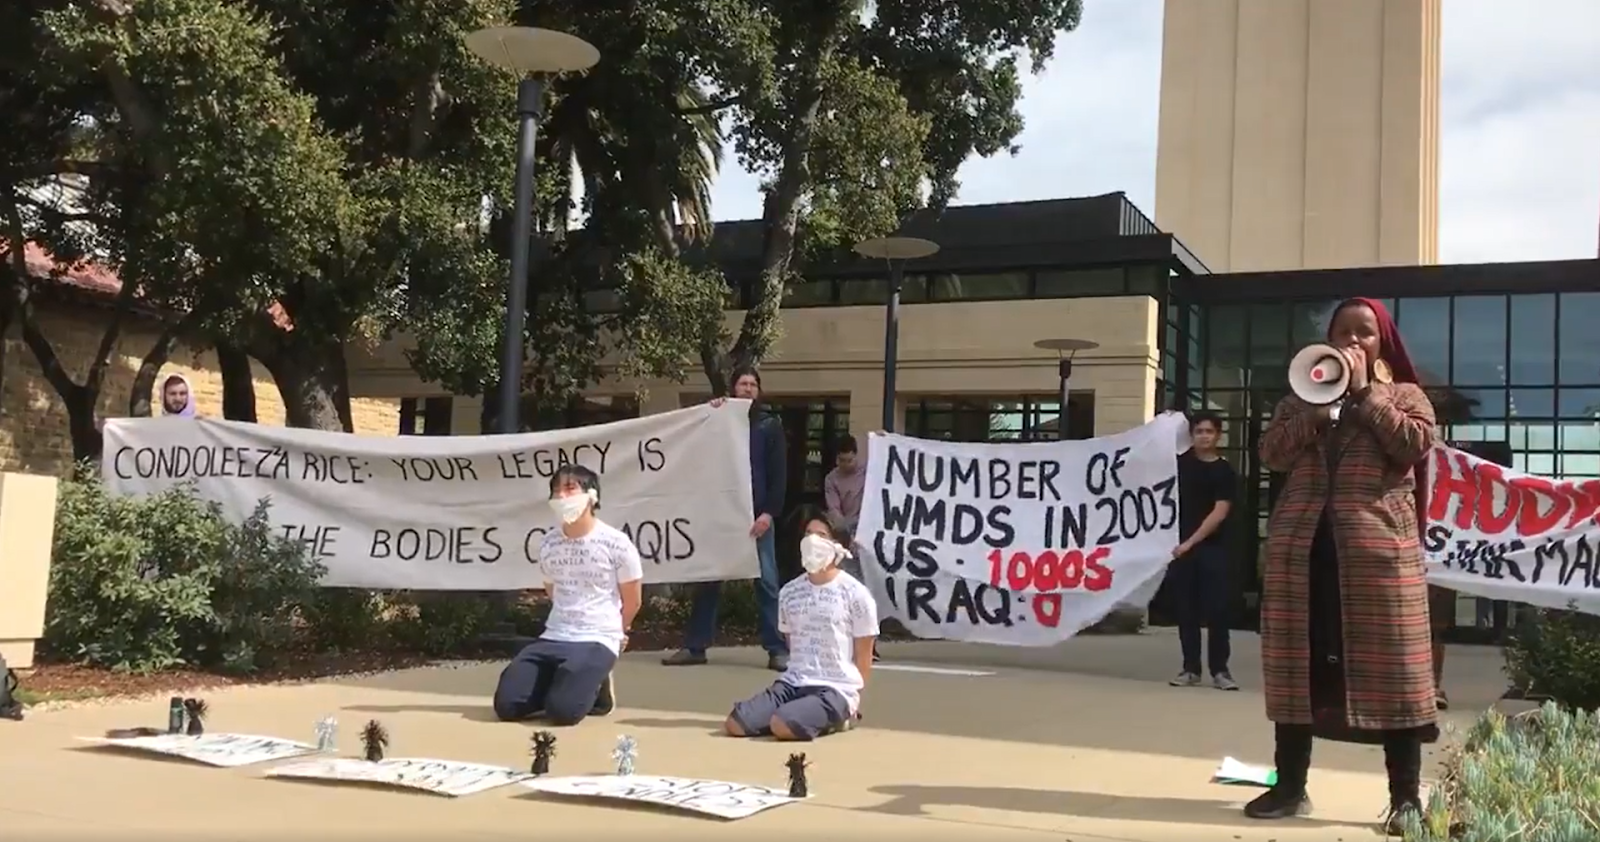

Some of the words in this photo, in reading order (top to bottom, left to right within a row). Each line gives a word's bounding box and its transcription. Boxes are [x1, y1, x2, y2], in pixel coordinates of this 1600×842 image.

[302, 452, 373, 484] RICE:
[392, 456, 478, 481] YOUR
[638, 437, 666, 472] IS
[885, 445, 1061, 501] NUMBER
[1086, 447, 1131, 495] OF
[881, 488, 1015, 548] WMDS
[1044, 503, 1087, 549] IN
[1095, 474, 1177, 545] 2003
[370, 526, 503, 563] BODIES
[987, 547, 1115, 592] 1000S
[885, 576, 1026, 627] IRAQ:
